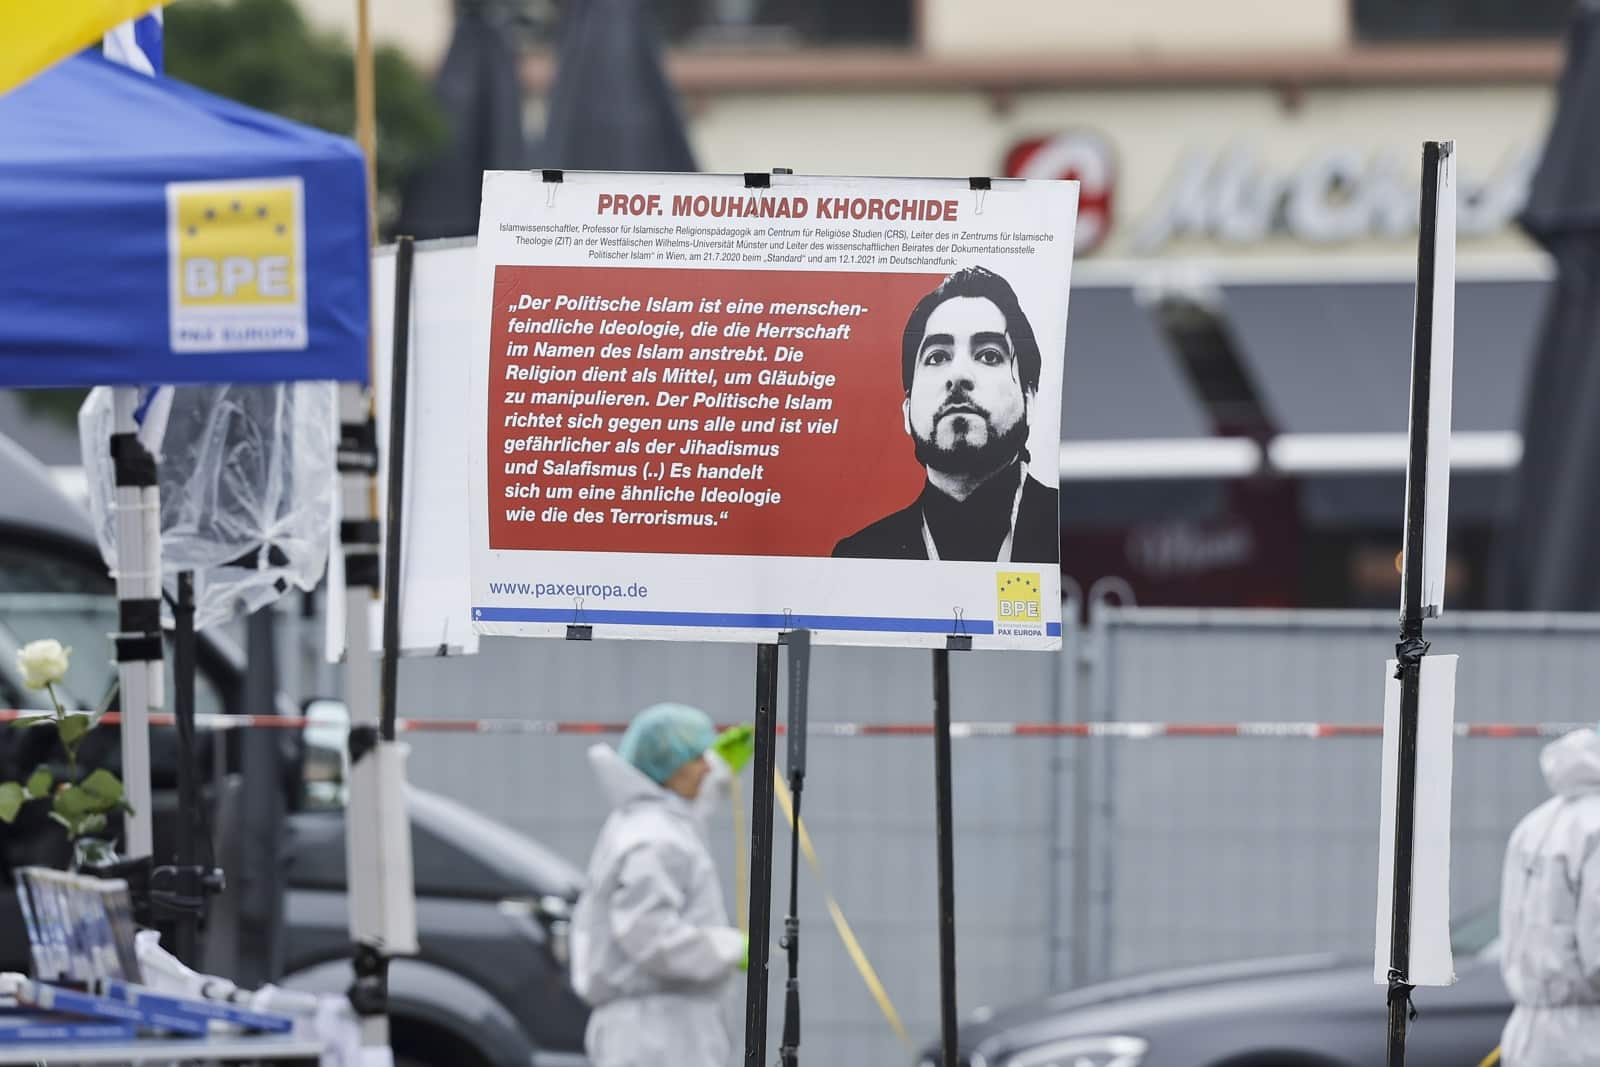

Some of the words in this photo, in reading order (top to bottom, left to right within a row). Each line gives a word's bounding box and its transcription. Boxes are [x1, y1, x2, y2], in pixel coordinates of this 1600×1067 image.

[597, 193, 663, 216] PROF.
[671, 195, 808, 219] MOUHANAD
[816, 197, 958, 221] KHORCHIDE
[581, 223, 619, 234] Professor
[620, 224, 631, 234] für
[632, 224, 674, 235] Islamische
[675, 225, 751, 238] Religionspädagogik
[767, 226, 801, 237] Centrum
[802, 227, 814, 237] für
[814, 228, 851, 240] Religiöse
[851, 228, 882, 238] Studien
[884, 228, 909, 241] (CRS),
[910, 230, 934, 239] Leiter
[934, 231, 950, 240] des
[951, 232, 959, 240] in
[960, 231, 998, 241] Zentrums
[999, 231, 1011, 241] für
[1012, 231, 1054, 242] Islamische
[515, 235, 553, 247] Theologie
[554, 236, 572, 247] (ZIT)
[573, 238, 584, 246] an
[584, 237, 599, 246] der
[599, 237, 653, 247] Westfälischen
[655, 238, 734, 249] Wilhelms-Universität
[735, 239, 768, 249] Münster
[769, 240, 785, 250] und
[785, 240, 808, 250] Leiter
[809, 241, 824, 250] des
[825, 241, 900, 252] wissenschaftlichen
[901, 242, 934, 252] Beirates
[935, 243, 949, 253] der
[950, 243, 1035, 254] Dokumentationsstelle
[588, 249, 629, 259] Politischer
[656, 250, 664, 260] in
[665, 251, 687, 261] Wien,
[688, 253, 702, 261] am
[703, 251, 741, 262] 21.7.2020
[742, 253, 762, 262] beim
[807, 254, 823, 264] und
[839, 254, 875, 264] 12.1.2021
[877, 255, 888, 264] im
[184, 255, 290, 298] BPE
[554, 294, 641, 312] Politische
[645, 296, 694, 313] Islam
[698, 297, 722, 313] ist
[726, 298, 764, 314] eine
[768, 300, 868, 316] menschen-
[507, 317, 594, 334] feindliche
[599, 319, 684, 339] Ideologie,
[690, 321, 718, 337] die
[723, 321, 750, 337] die
[755, 322, 851, 339] Herrschaft
[506, 341, 528, 357] im
[533, 341, 595, 358] Namen
[600, 343, 632, 359] des
[636, 343, 684, 359] Islam
[688, 345, 768, 362] anstrebt.
[773, 346, 804, 362] Die
[505, 365, 577, 385] Religion
[581, 366, 628, 384] dient
[631, 368, 657, 383] als
[662, 368, 718, 387] Mittel,
[724, 372, 752, 385] um
[757, 370, 836, 389] Gläubige
[503, 391, 526, 404] zu
[530, 389, 650, 408] manipulieren.
[655, 391, 689, 407] Der
[692, 392, 779, 409] Politische
[784, 394, 832, 410] Islam
[504, 412, 562, 428] richtet
[567, 413, 603, 429] sich
[607, 417, 662, 433] gegen
[667, 418, 699, 431] uns
[703, 416, 735, 432] alle
[741, 417, 776, 433] und
[779, 418, 802, 433] ist
[807, 418, 839, 434] viel
[503, 436, 611, 454] gefährlicher
[614, 437, 640, 453] als
[645, 438, 676, 454] der
[679, 439, 780, 457] Jihadismus
[504, 459, 538, 475] und
[542, 460, 637, 477] Salafismus
[669, 462, 692, 478] Es
[696, 463, 764, 480] handelt
[504, 482, 540, 498] sich
[545, 487, 573, 499] um
[578, 484, 615, 500] eine
[620, 485, 695, 502] ähnliche
[700, 486, 781, 507] Ideologie
[505, 506, 536, 522] wie
[541, 506, 568, 522] die
[573, 507, 604, 523] des
[489, 582, 647, 599] www.paxeuropa.de
[1000, 600, 1040, 617] BPE
[997, 628, 1012, 636] PAX
[1013, 629, 1042, 637] EUROPA
